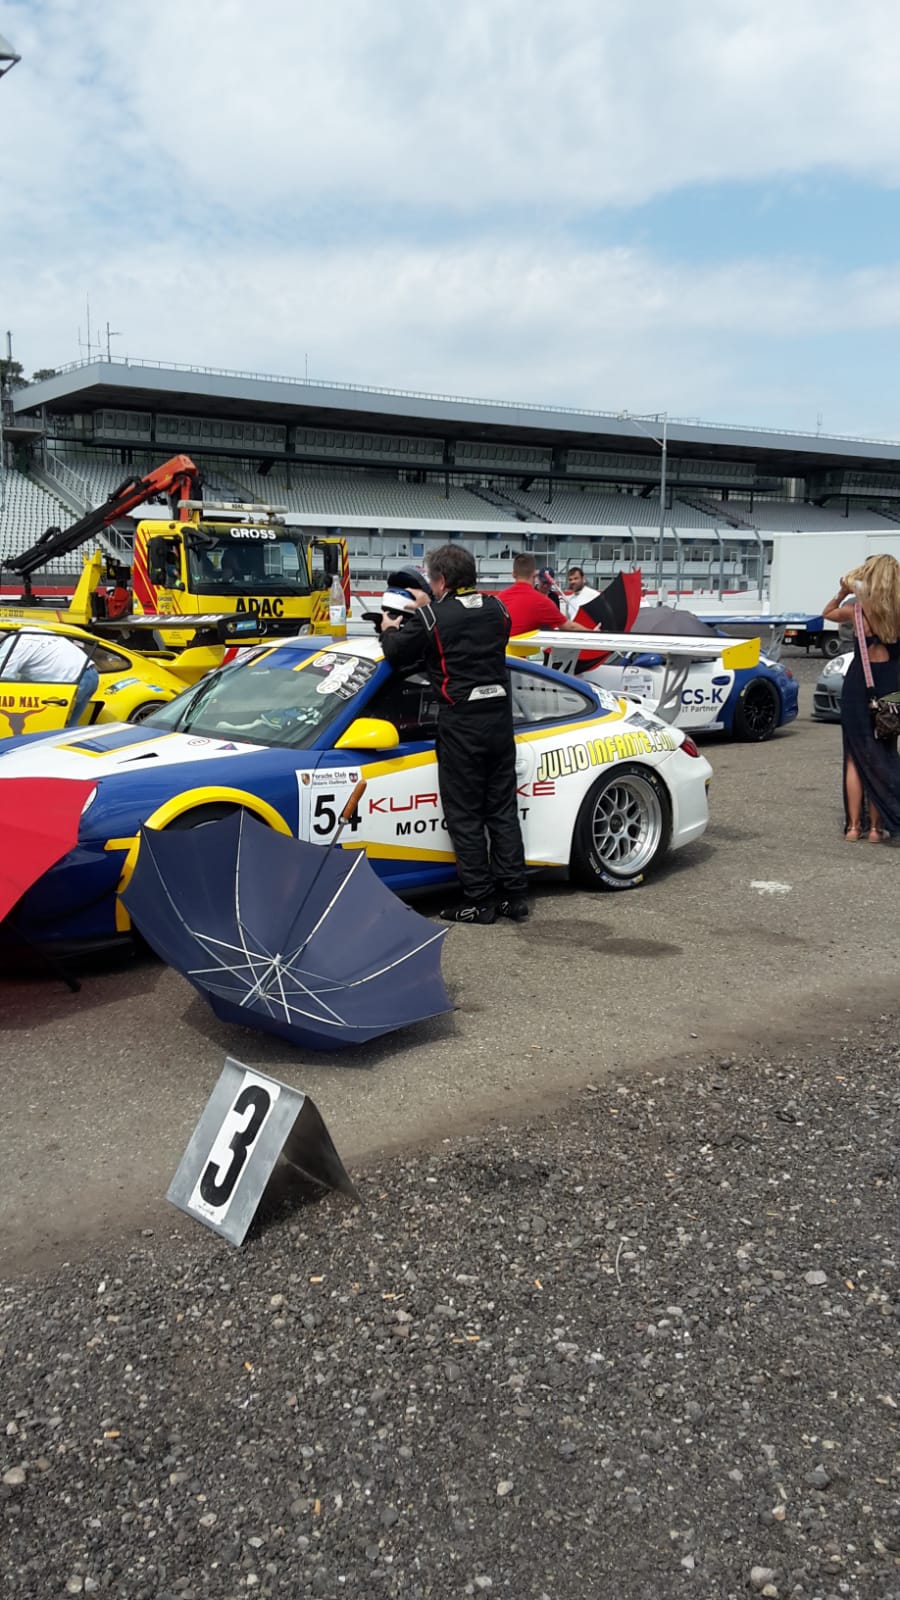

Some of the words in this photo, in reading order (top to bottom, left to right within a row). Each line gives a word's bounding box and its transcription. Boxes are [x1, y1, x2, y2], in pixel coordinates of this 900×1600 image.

[230, 527, 276, 539] GROSS
[235, 597, 284, 617] ADAC
[0, 695, 15, 707] AD
[20, 696, 40, 708] MAX
[681, 688, 723, 705] CS-K
[690, 705, 718, 713] Partner
[313, 794, 362, 836] 54
[200, 1085, 271, 1208] 3
